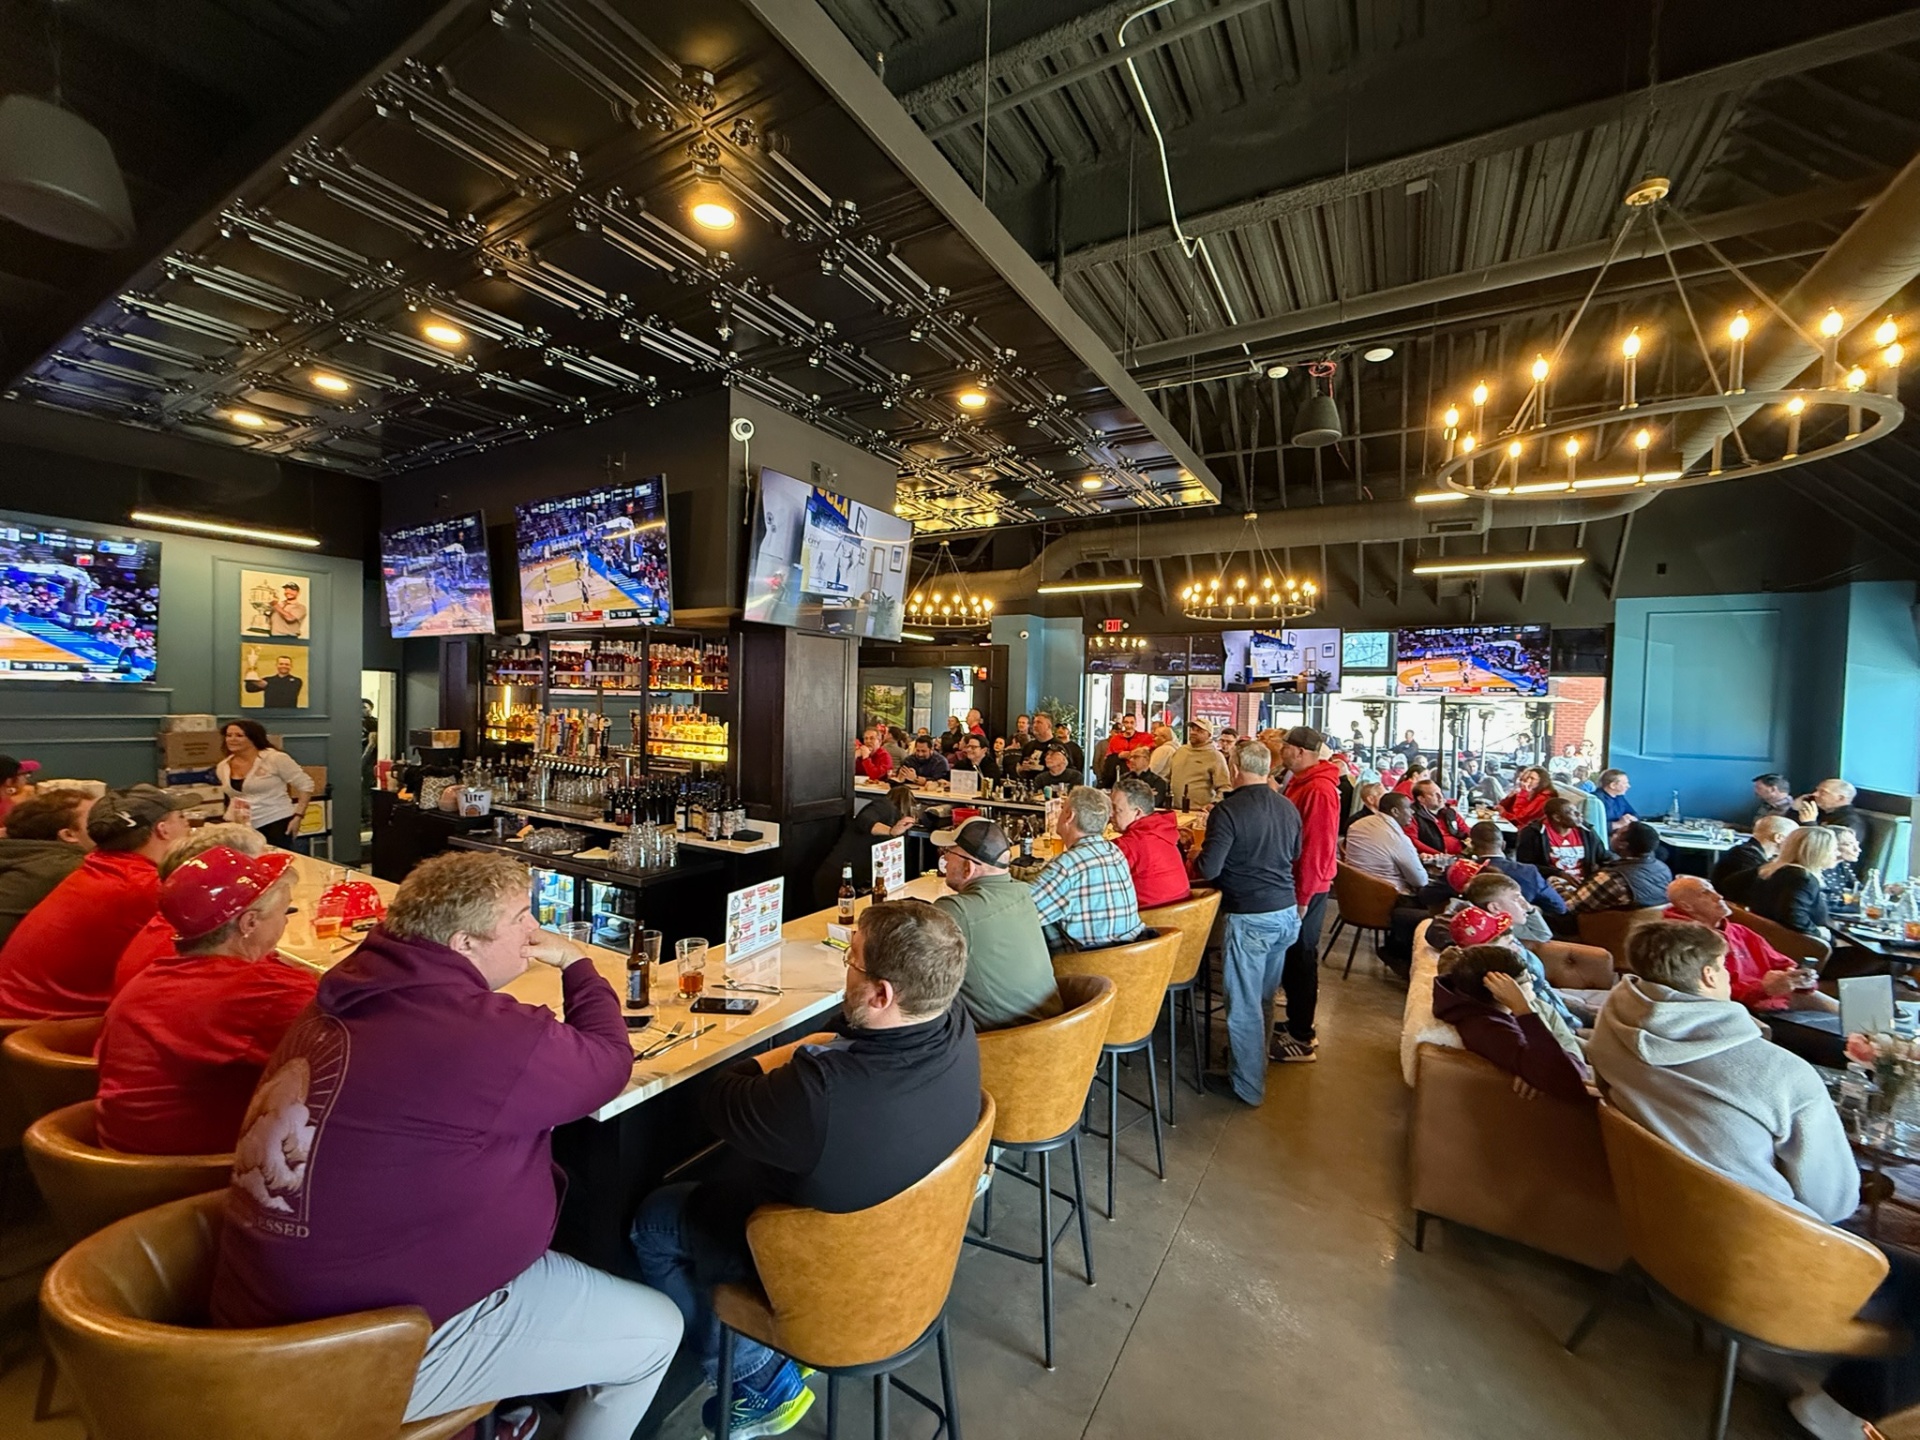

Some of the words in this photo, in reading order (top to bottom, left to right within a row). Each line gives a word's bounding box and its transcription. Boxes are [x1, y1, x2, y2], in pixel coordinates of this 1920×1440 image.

[1106, 620, 1120, 632] EXIT
[464, 794, 484, 803] Lite
[255, 1217, 310, 1239] ESSED
